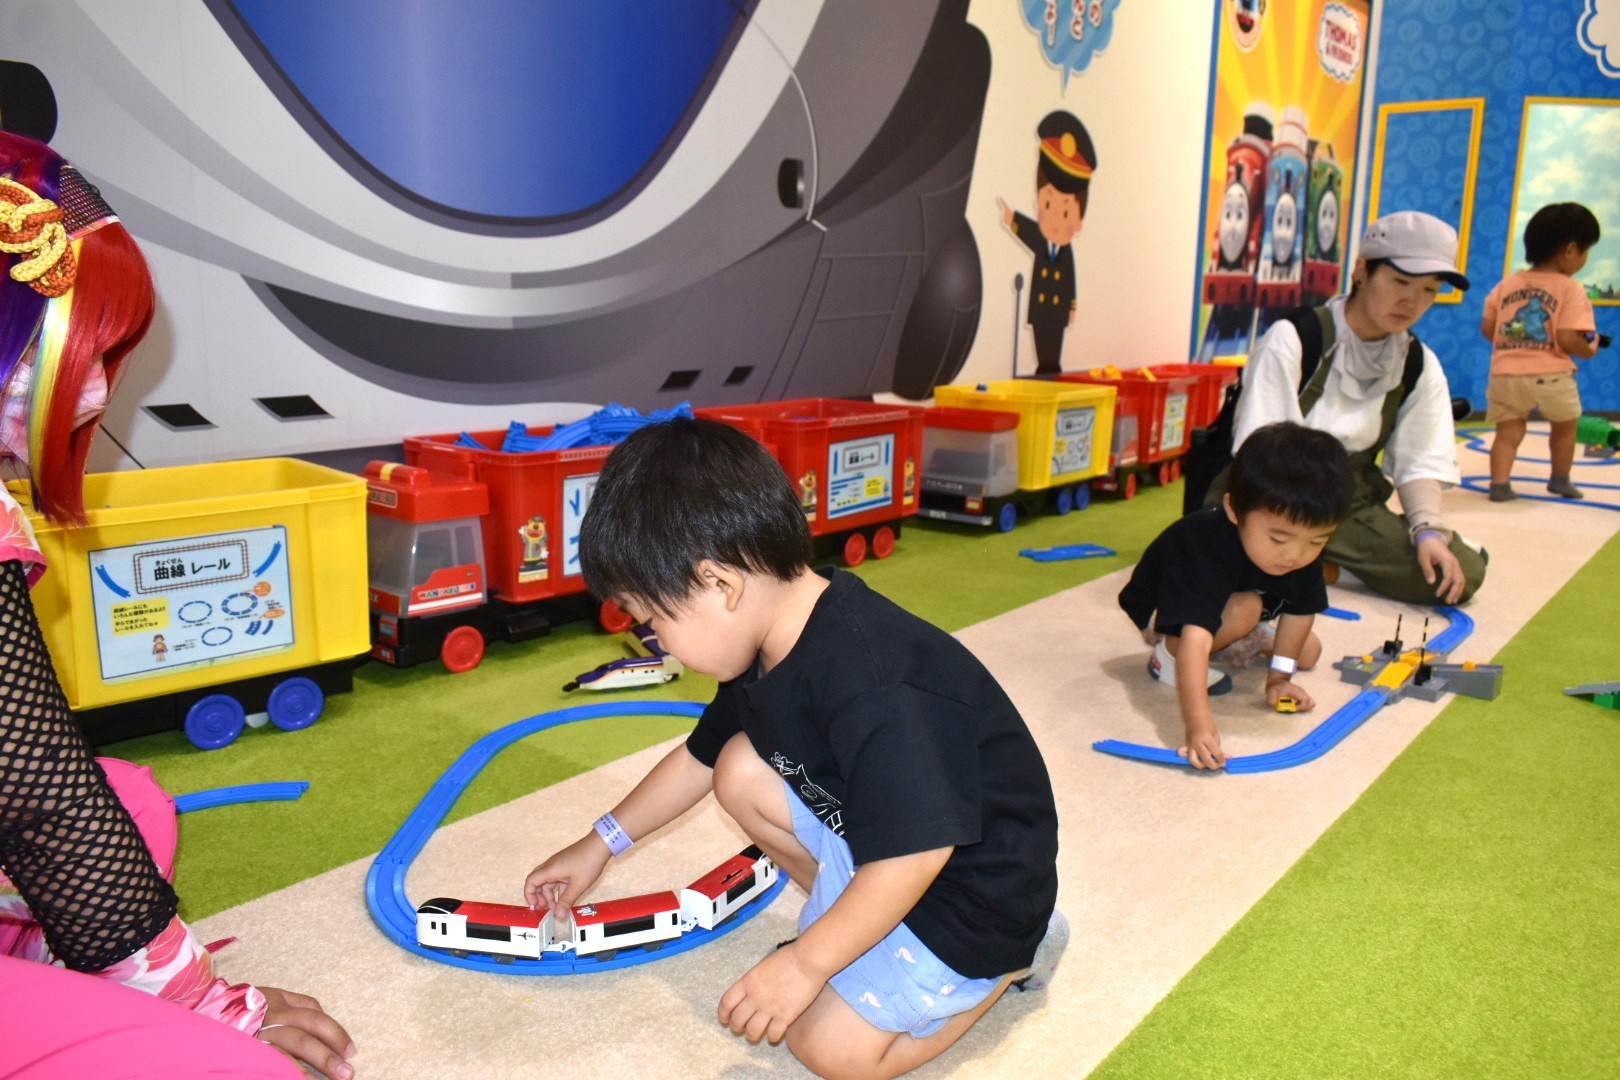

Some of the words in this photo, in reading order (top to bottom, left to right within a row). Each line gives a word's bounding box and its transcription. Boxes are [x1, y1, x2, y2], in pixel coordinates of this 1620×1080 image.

[1501, 287, 1559, 313] MONSTERS
[154, 563, 186, 581] 曲線
[191, 558, 231, 575] レール
[155, 557, 183, 567] きょくせん
